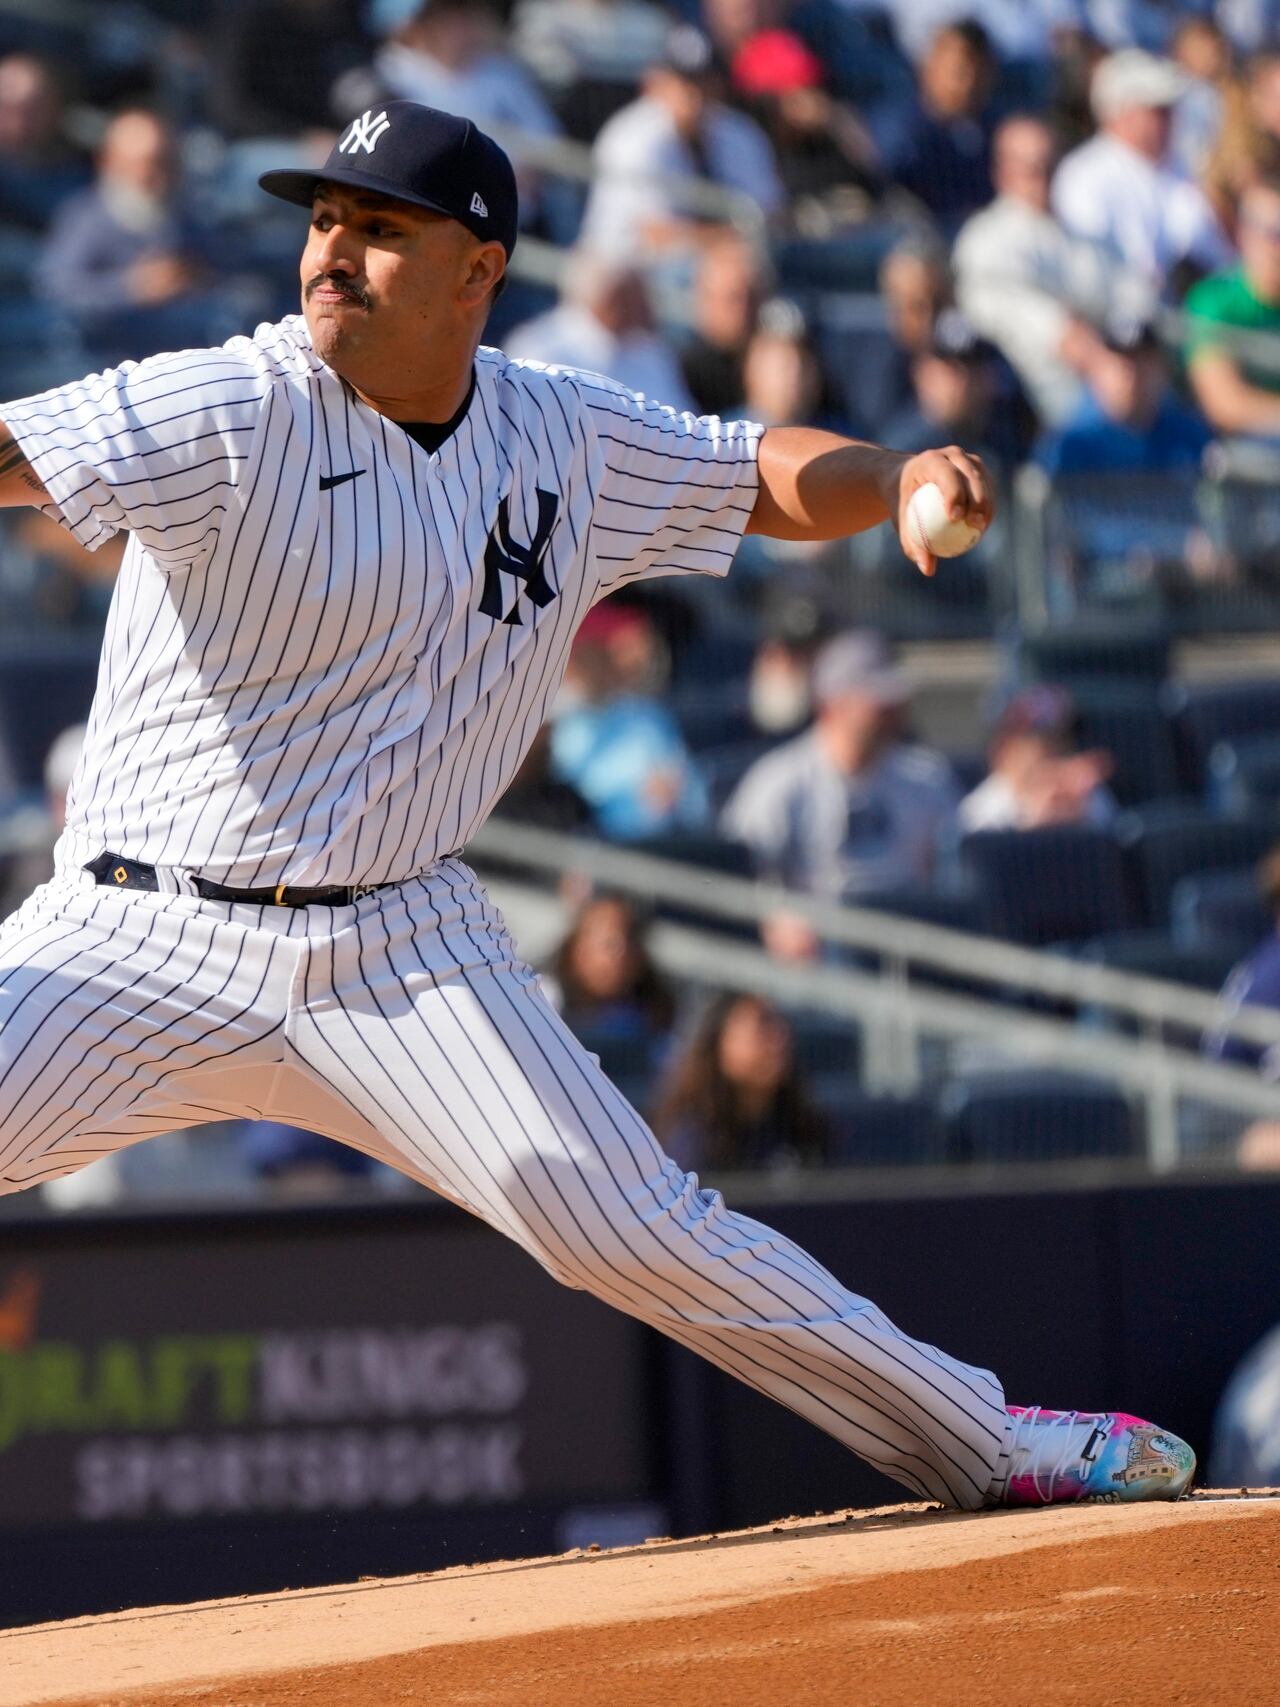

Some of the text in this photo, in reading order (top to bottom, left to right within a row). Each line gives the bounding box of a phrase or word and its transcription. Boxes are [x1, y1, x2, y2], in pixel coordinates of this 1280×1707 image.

[338, 110, 391, 155] NY
[478, 487, 561, 626] NY
[76, 1423, 524, 1521] SPORTSBOOK
